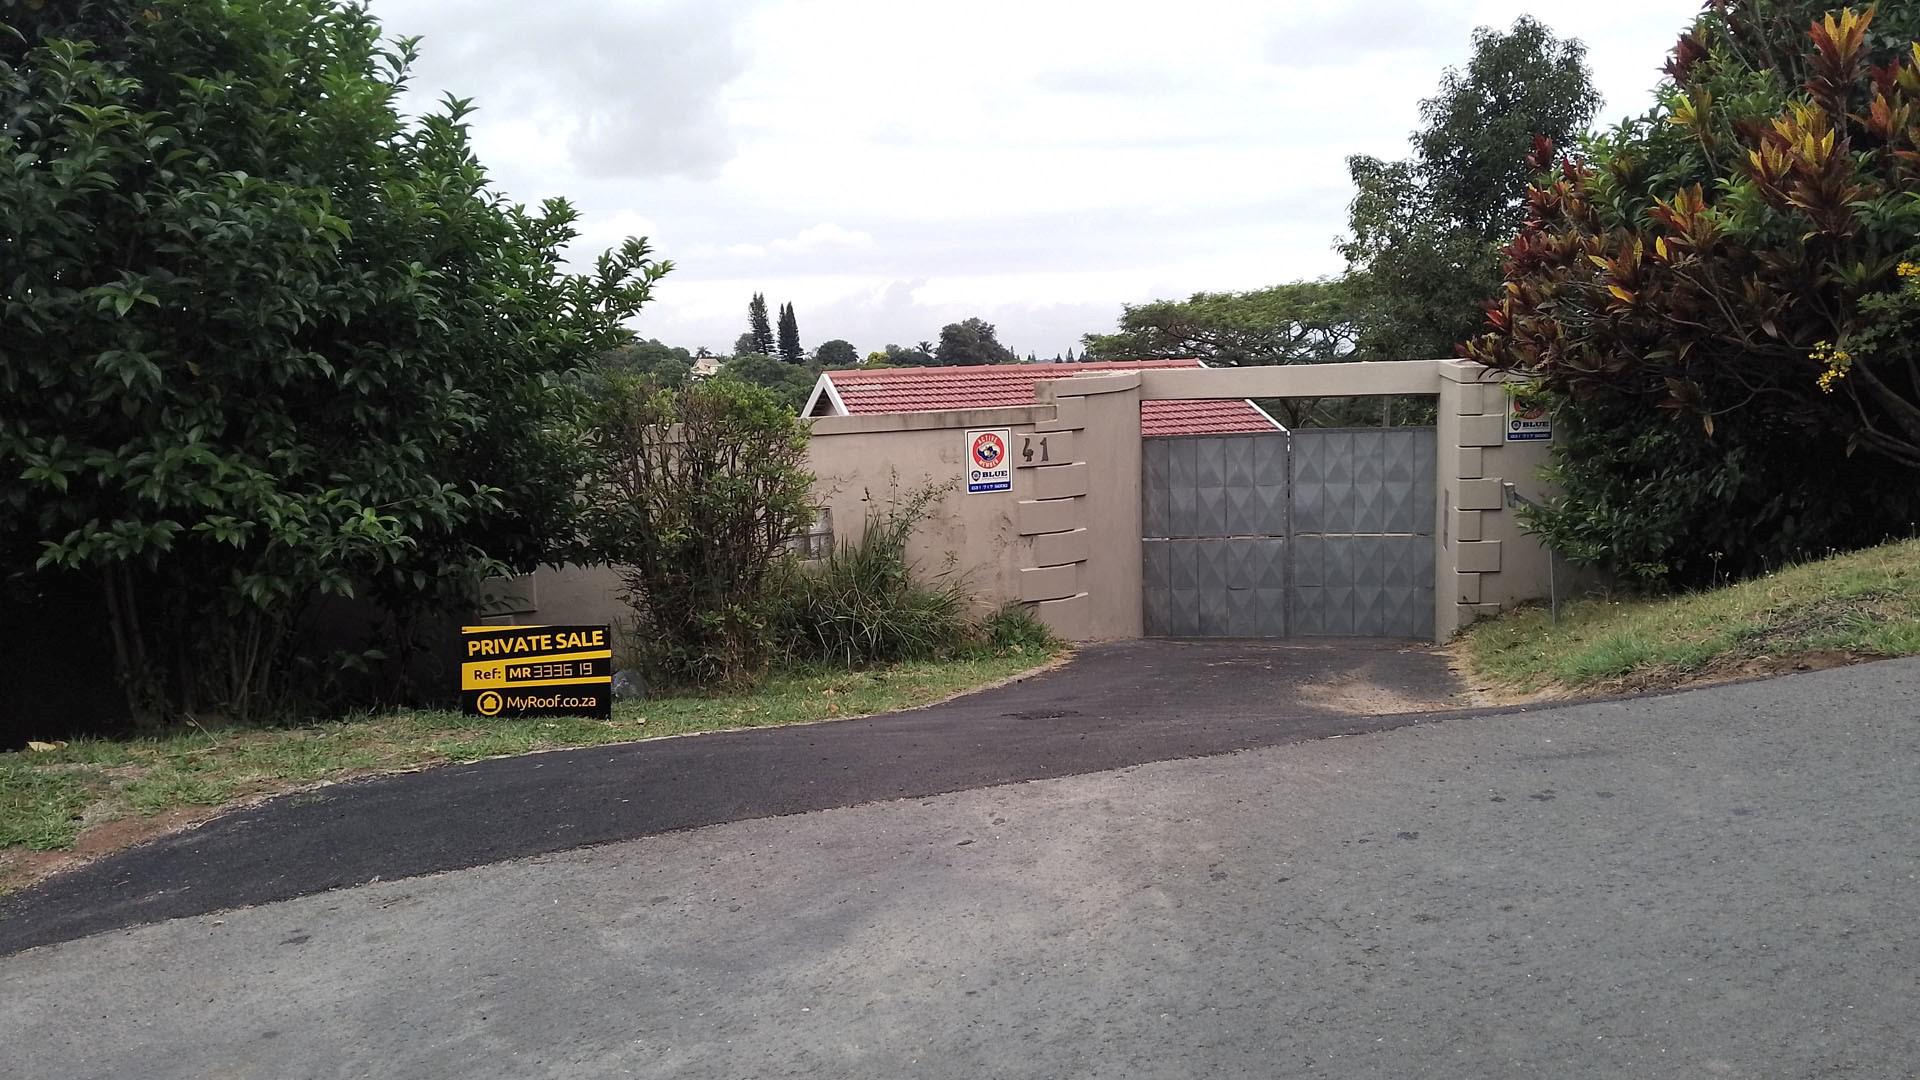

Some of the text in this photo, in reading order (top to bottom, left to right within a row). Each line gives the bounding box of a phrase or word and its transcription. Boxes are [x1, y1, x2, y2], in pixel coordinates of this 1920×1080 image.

[977, 435, 998, 445] ACTIVE
[1022, 437, 1049, 462] 41
[978, 459, 999, 468] MEMBER
[467, 630, 605, 657] PRIVATE SALE
[474, 668, 502, 680] Ref:
[506, 694, 597, 711] MyRoof.co.za
